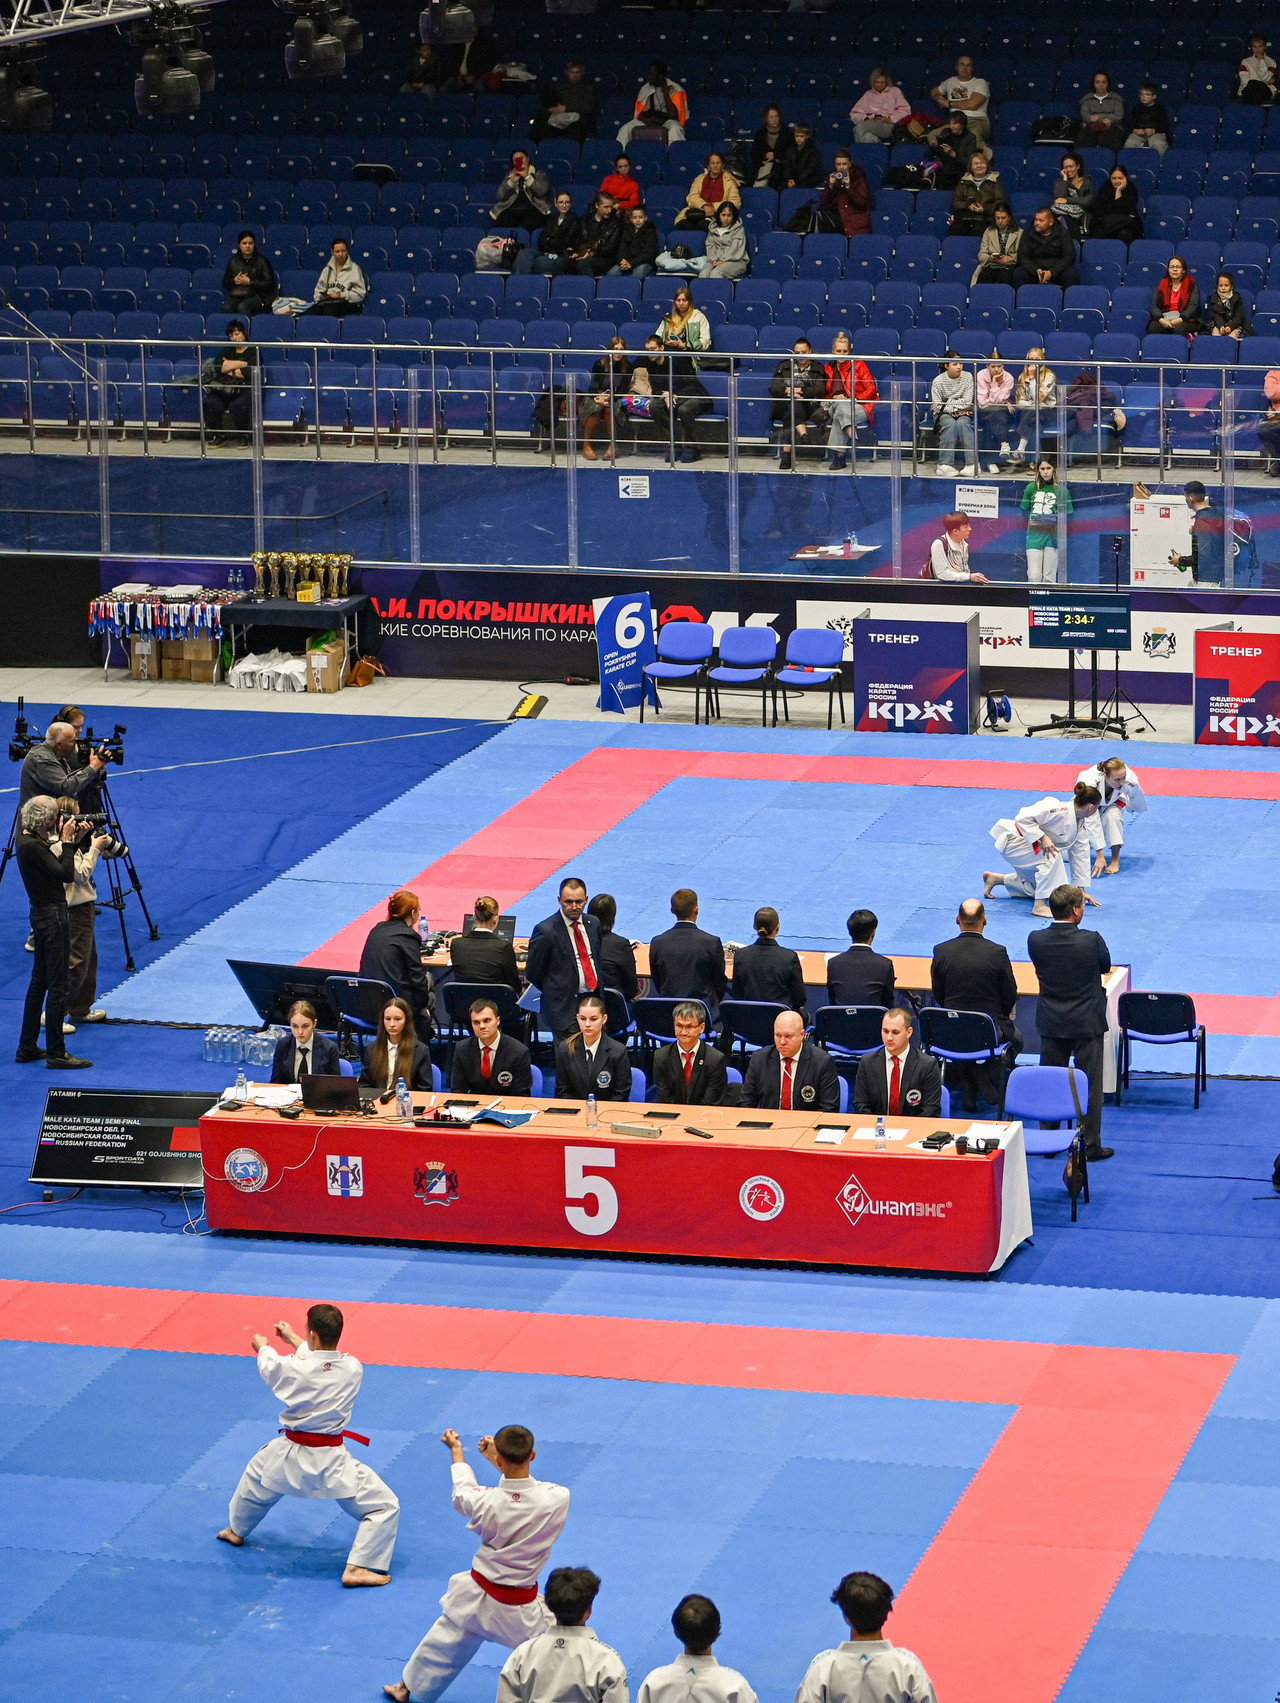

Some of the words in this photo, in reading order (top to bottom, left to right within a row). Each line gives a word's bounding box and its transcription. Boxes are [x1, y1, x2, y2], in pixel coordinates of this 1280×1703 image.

[372, 597, 412, 618] .И.
[1064, 614, 1095, 625] 2:34.7
[615, 602, 645, 649] 6
[379, 622, 408, 637] КИЕ
[412, 624, 531, 641] СОРЕВНОВАНИЯ
[535, 628, 556, 642] ПО
[868, 633, 919, 644] ТРЕНЕР
[603, 651, 619, 660] OPEN
[1210, 646, 1262, 657] ТРЕНЕР
[604, 651, 637, 667] POKRYSHKIN
[604, 662, 625, 674] KARATE
[625, 659, 637, 667] CUP
[50, 1090, 76, 1098] ТАТАМИ
[44, 1124, 103, 1132] НОВОСИБИРСКАЯ
[42, 1131, 101, 1139] НОВОСИБИРСКАЯ
[102, 1133, 134, 1141] ОБЛАСТЬ
[54, 1139, 84, 1147] RUSSIAN
[84, 1140, 127, 1148] FEDERATION
[564, 1145, 618, 1237] 5
